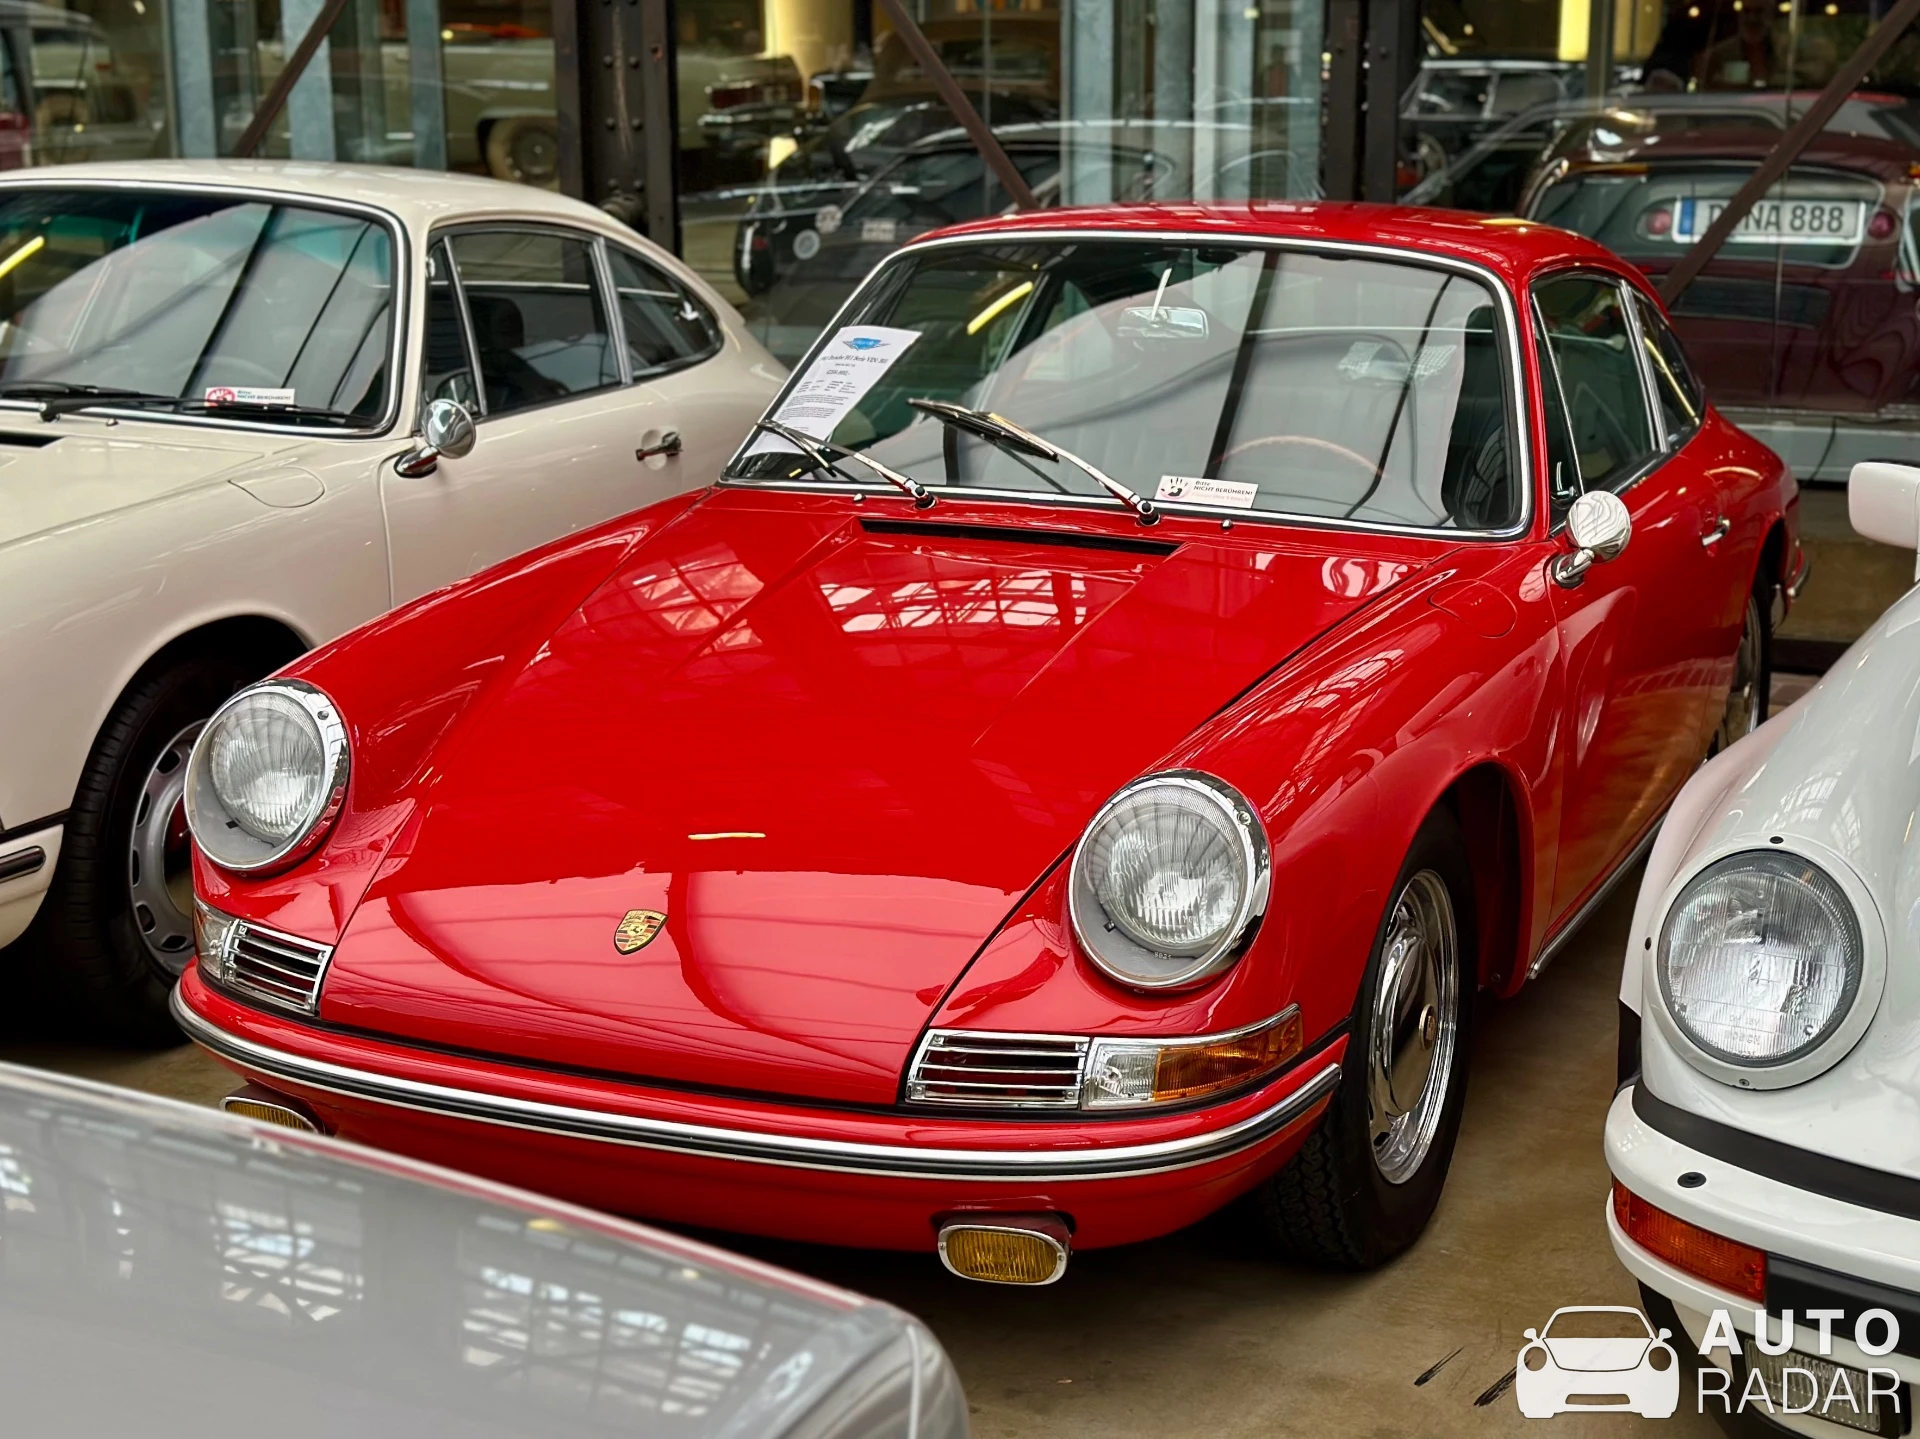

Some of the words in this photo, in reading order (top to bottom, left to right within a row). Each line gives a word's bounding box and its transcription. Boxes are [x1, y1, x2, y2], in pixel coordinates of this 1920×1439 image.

[1744, 203, 1780, 231] NA
[1790, 204, 1844, 232] 888
[1215, 487, 1253, 495] BERÜHREN!
